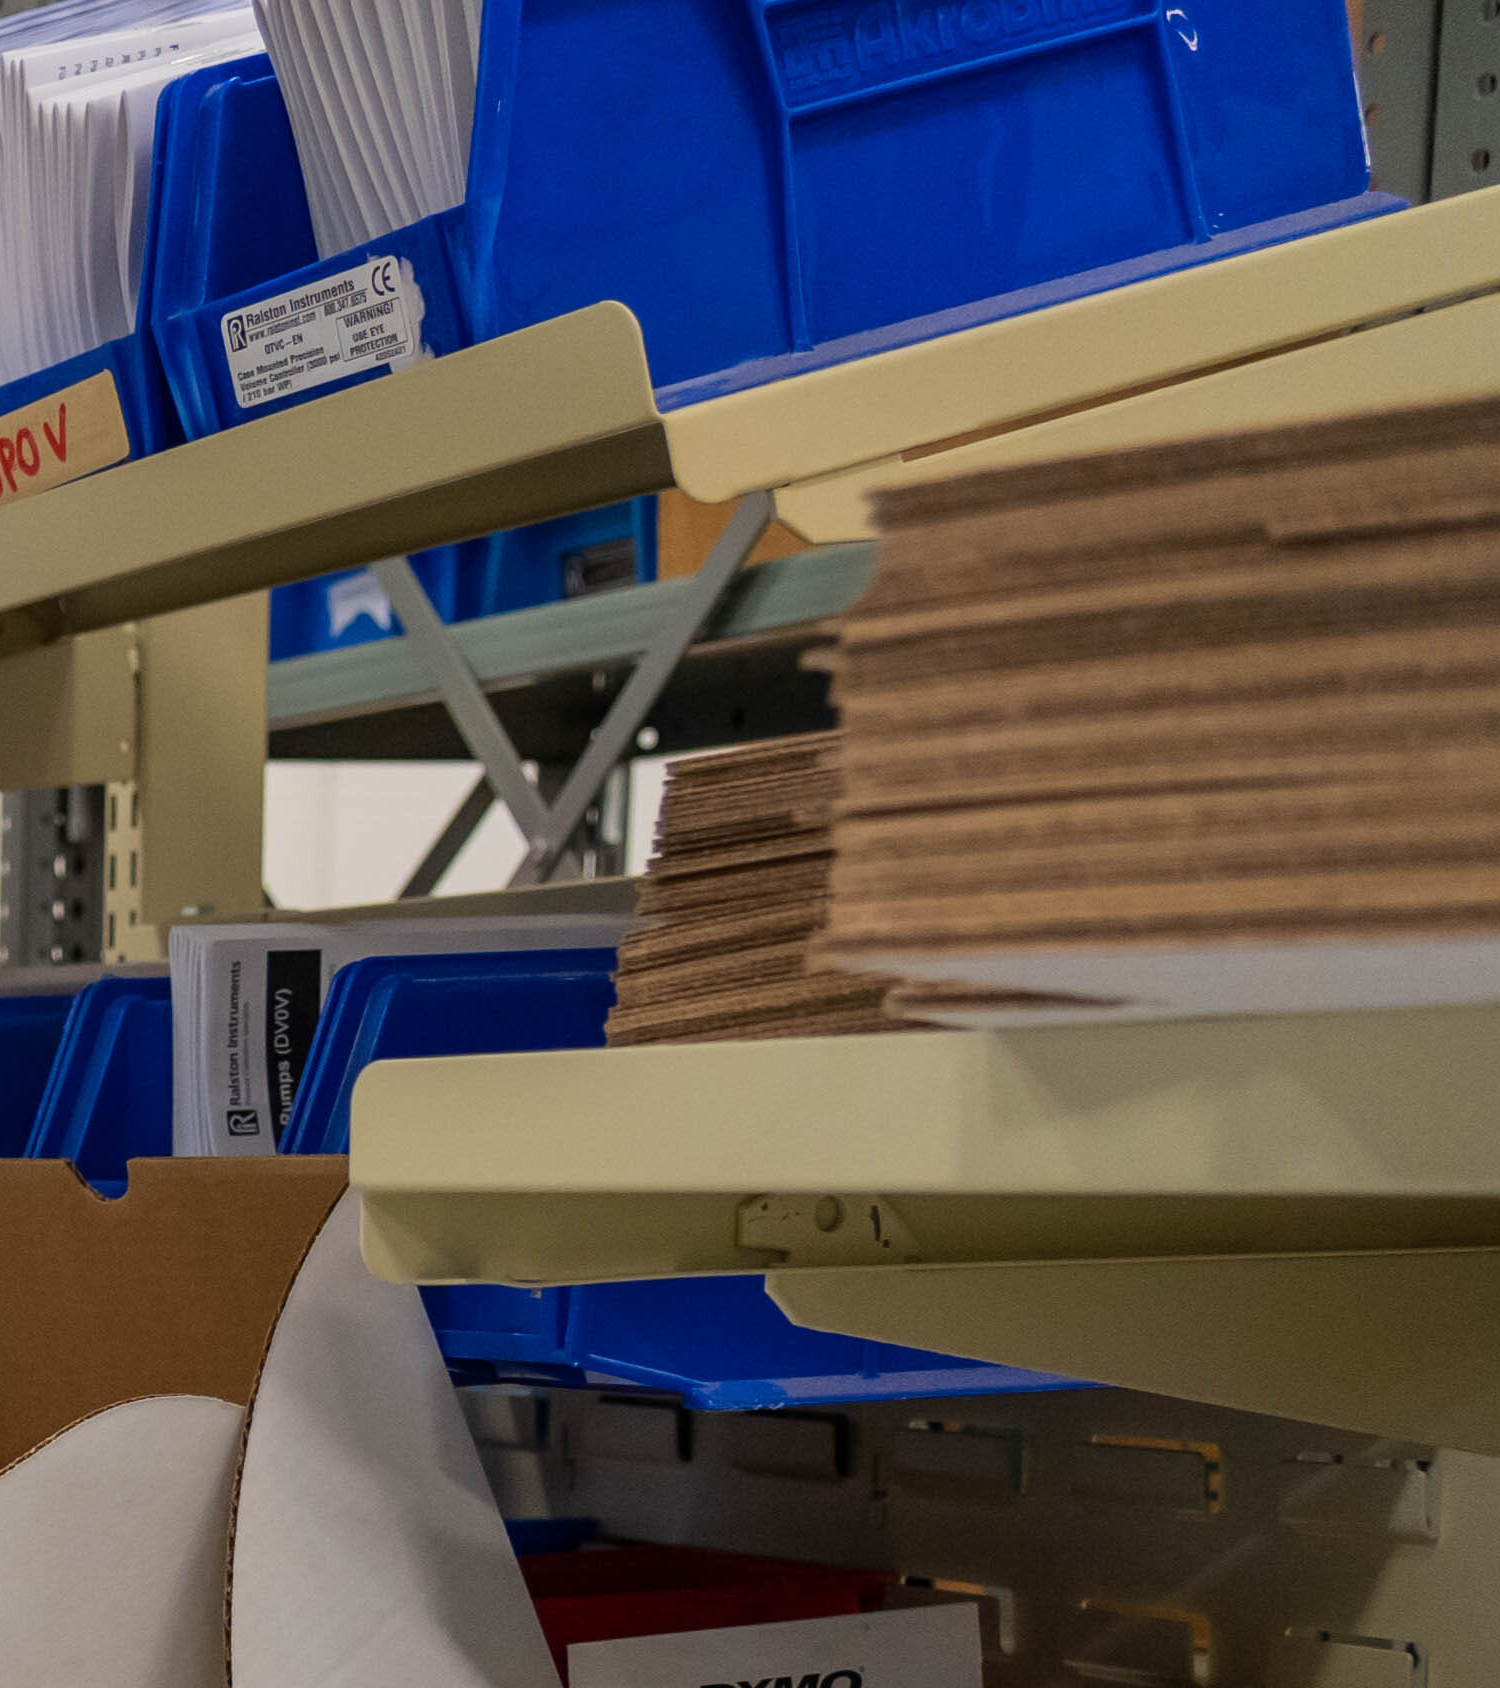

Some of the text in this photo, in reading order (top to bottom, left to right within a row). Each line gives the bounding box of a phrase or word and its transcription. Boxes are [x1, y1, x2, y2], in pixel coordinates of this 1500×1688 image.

[246, 279, 355, 328] Ralston Instruments
[343, 302, 394, 328] WARNING!
[350, 333, 398, 356] PROTECTION
[228, 960, 241, 1107] Ralston Instruments
